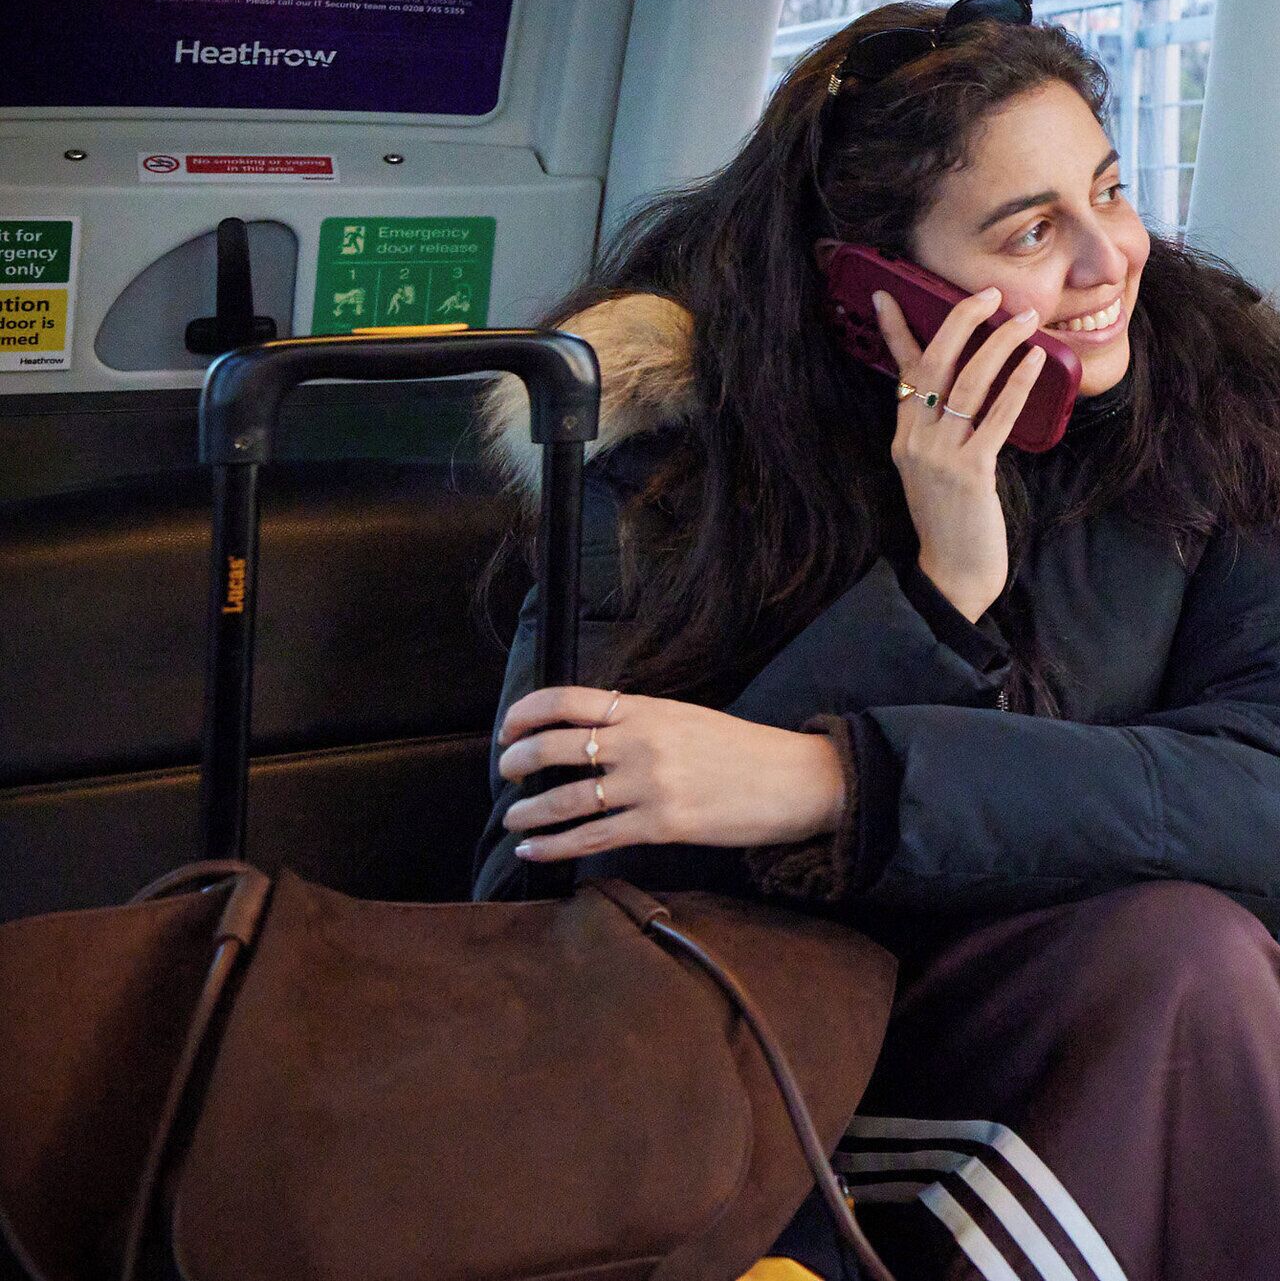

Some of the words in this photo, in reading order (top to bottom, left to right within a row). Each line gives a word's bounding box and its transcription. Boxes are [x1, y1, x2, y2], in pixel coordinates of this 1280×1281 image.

[325, 0, 361, 10] Security
[175, 39, 338, 68] Heathrow
[193, 157, 210, 165] No
[214, 158, 266, 166] smoking
[286, 159, 326, 167] vaping
[16, 229, 42, 242] for
[379, 226, 470, 240] Emergency
[377, 243, 414, 254] door
[419, 244, 478, 253] release
[5, 263, 45, 278] only
[349, 269, 356, 280] 1
[400, 268, 410, 280] 2
[452, 268, 463, 279] 3
[0, 297, 50, 313] tion
[42, 317, 55, 329] is
[0, 334, 39, 346] med
